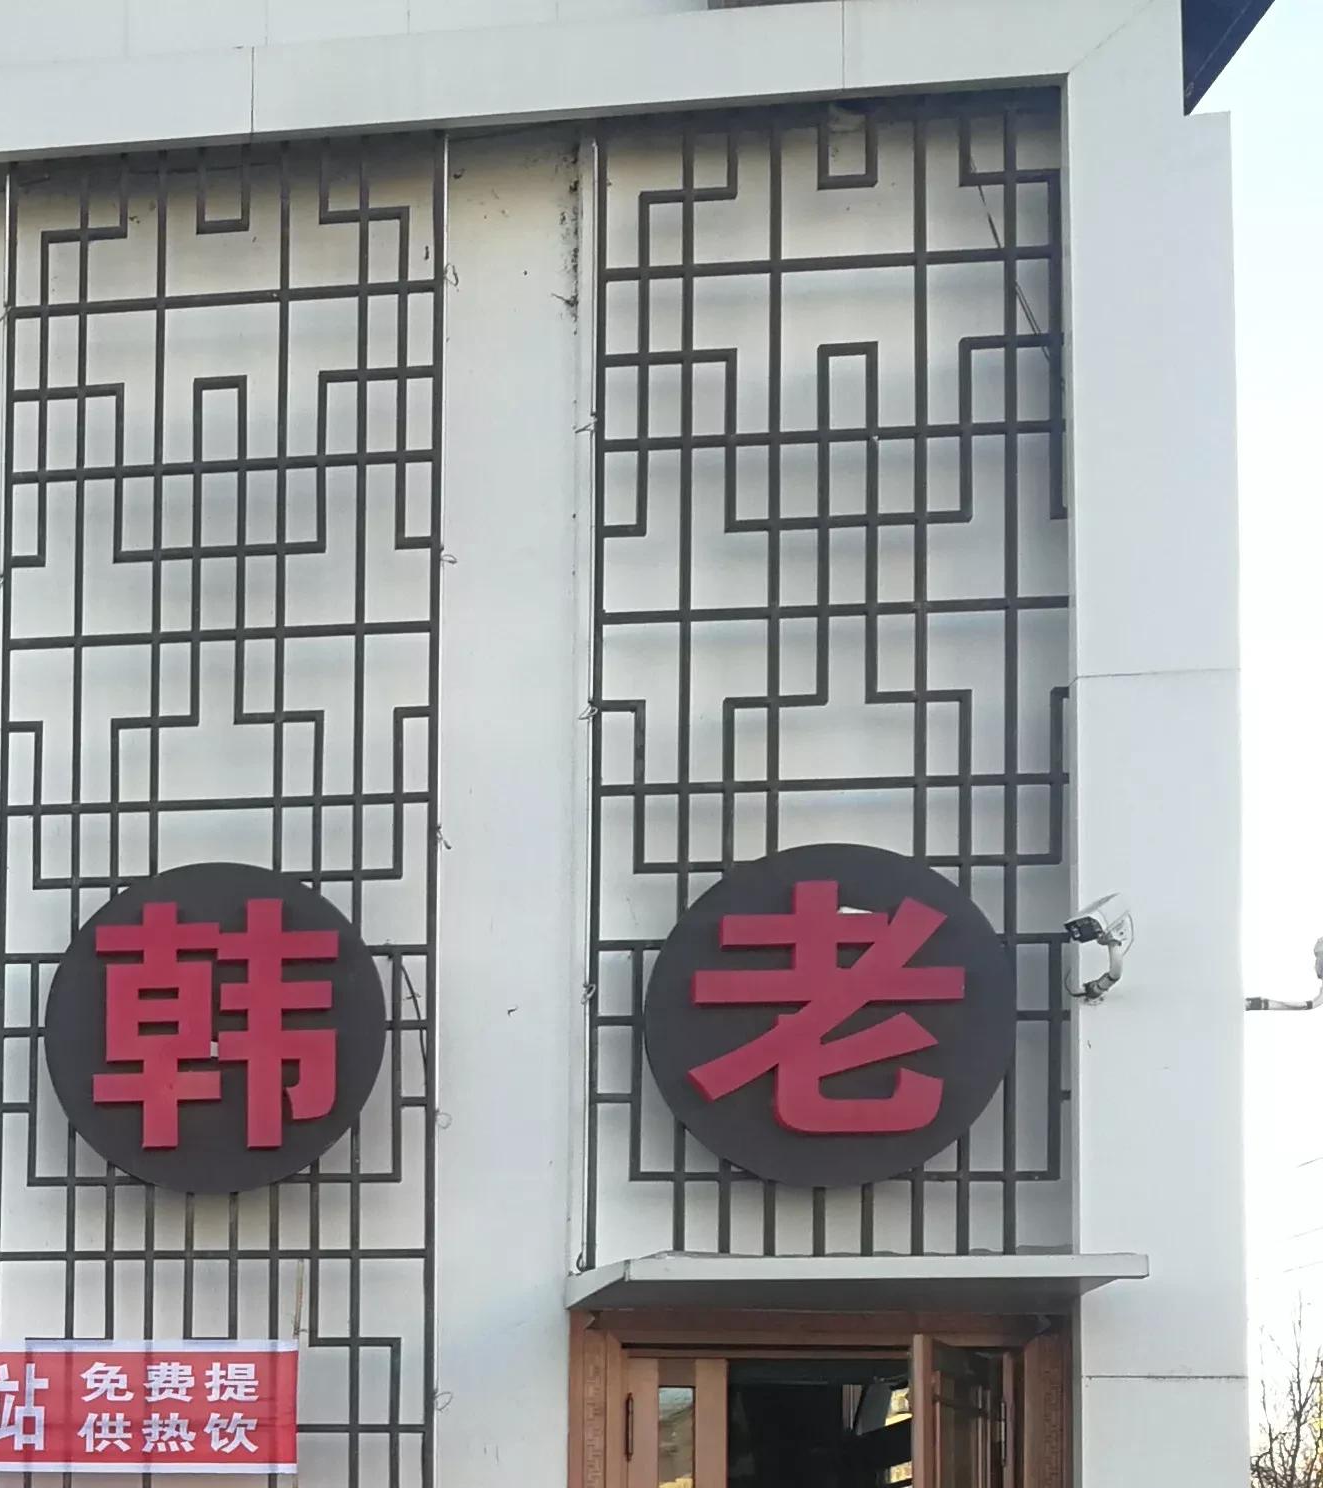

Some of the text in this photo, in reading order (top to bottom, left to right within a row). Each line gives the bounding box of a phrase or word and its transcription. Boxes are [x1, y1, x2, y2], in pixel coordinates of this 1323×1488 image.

[92, 898, 339, 1150] 韩
[687, 879, 965, 1135] 老
[77, 1411, 260, 1455] 供热饮
[78, 1360, 260, 1404] 免费提
